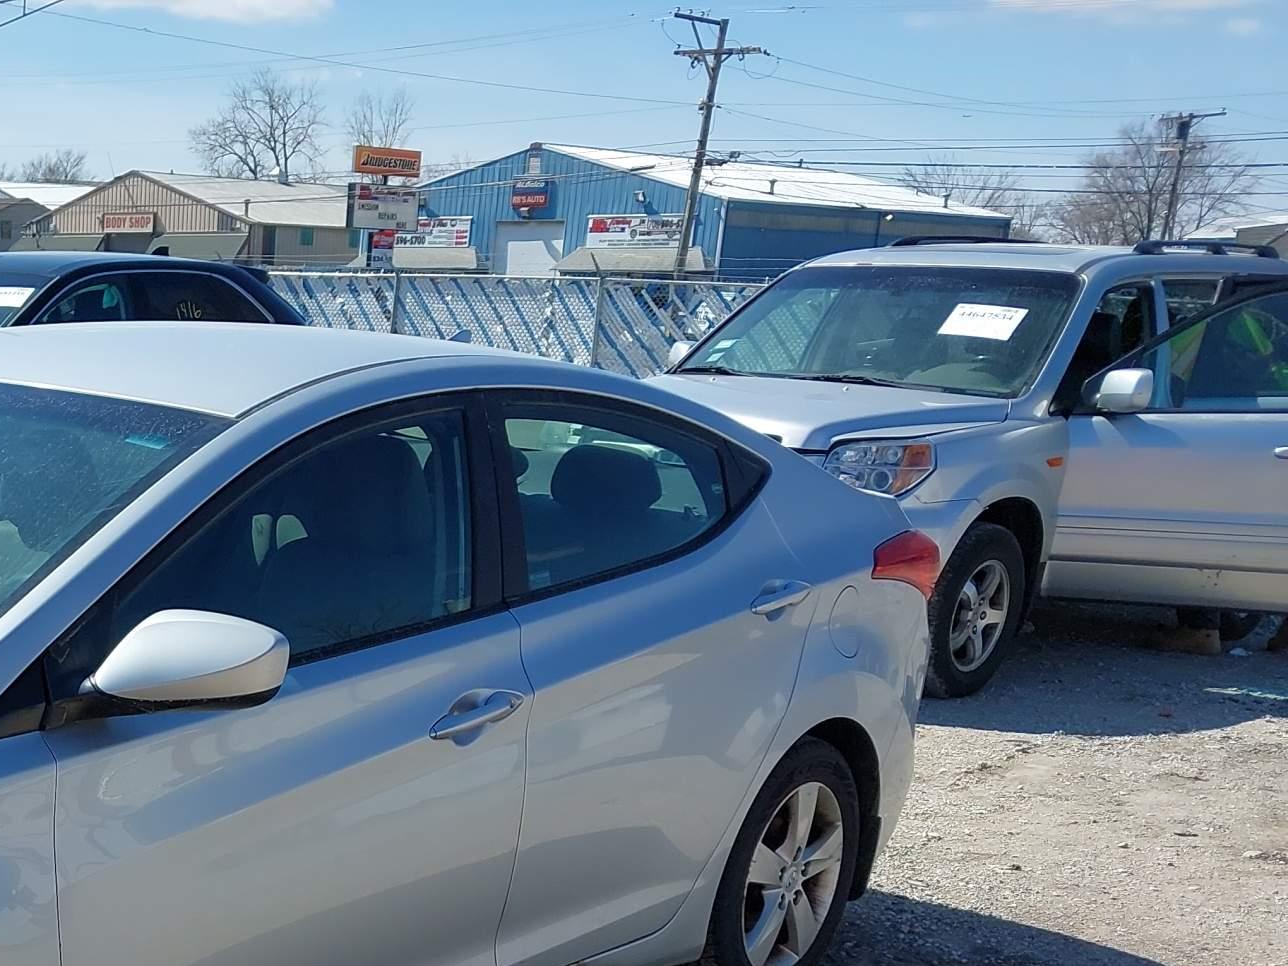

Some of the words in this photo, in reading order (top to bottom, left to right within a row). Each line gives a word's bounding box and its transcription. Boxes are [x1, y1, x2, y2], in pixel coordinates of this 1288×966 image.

[360, 153, 418, 171] BRIDGESTONE
[527, 195, 545, 203] AUTO
[105, 216, 126, 229] BODY
[129, 216, 151, 229] SHOP
